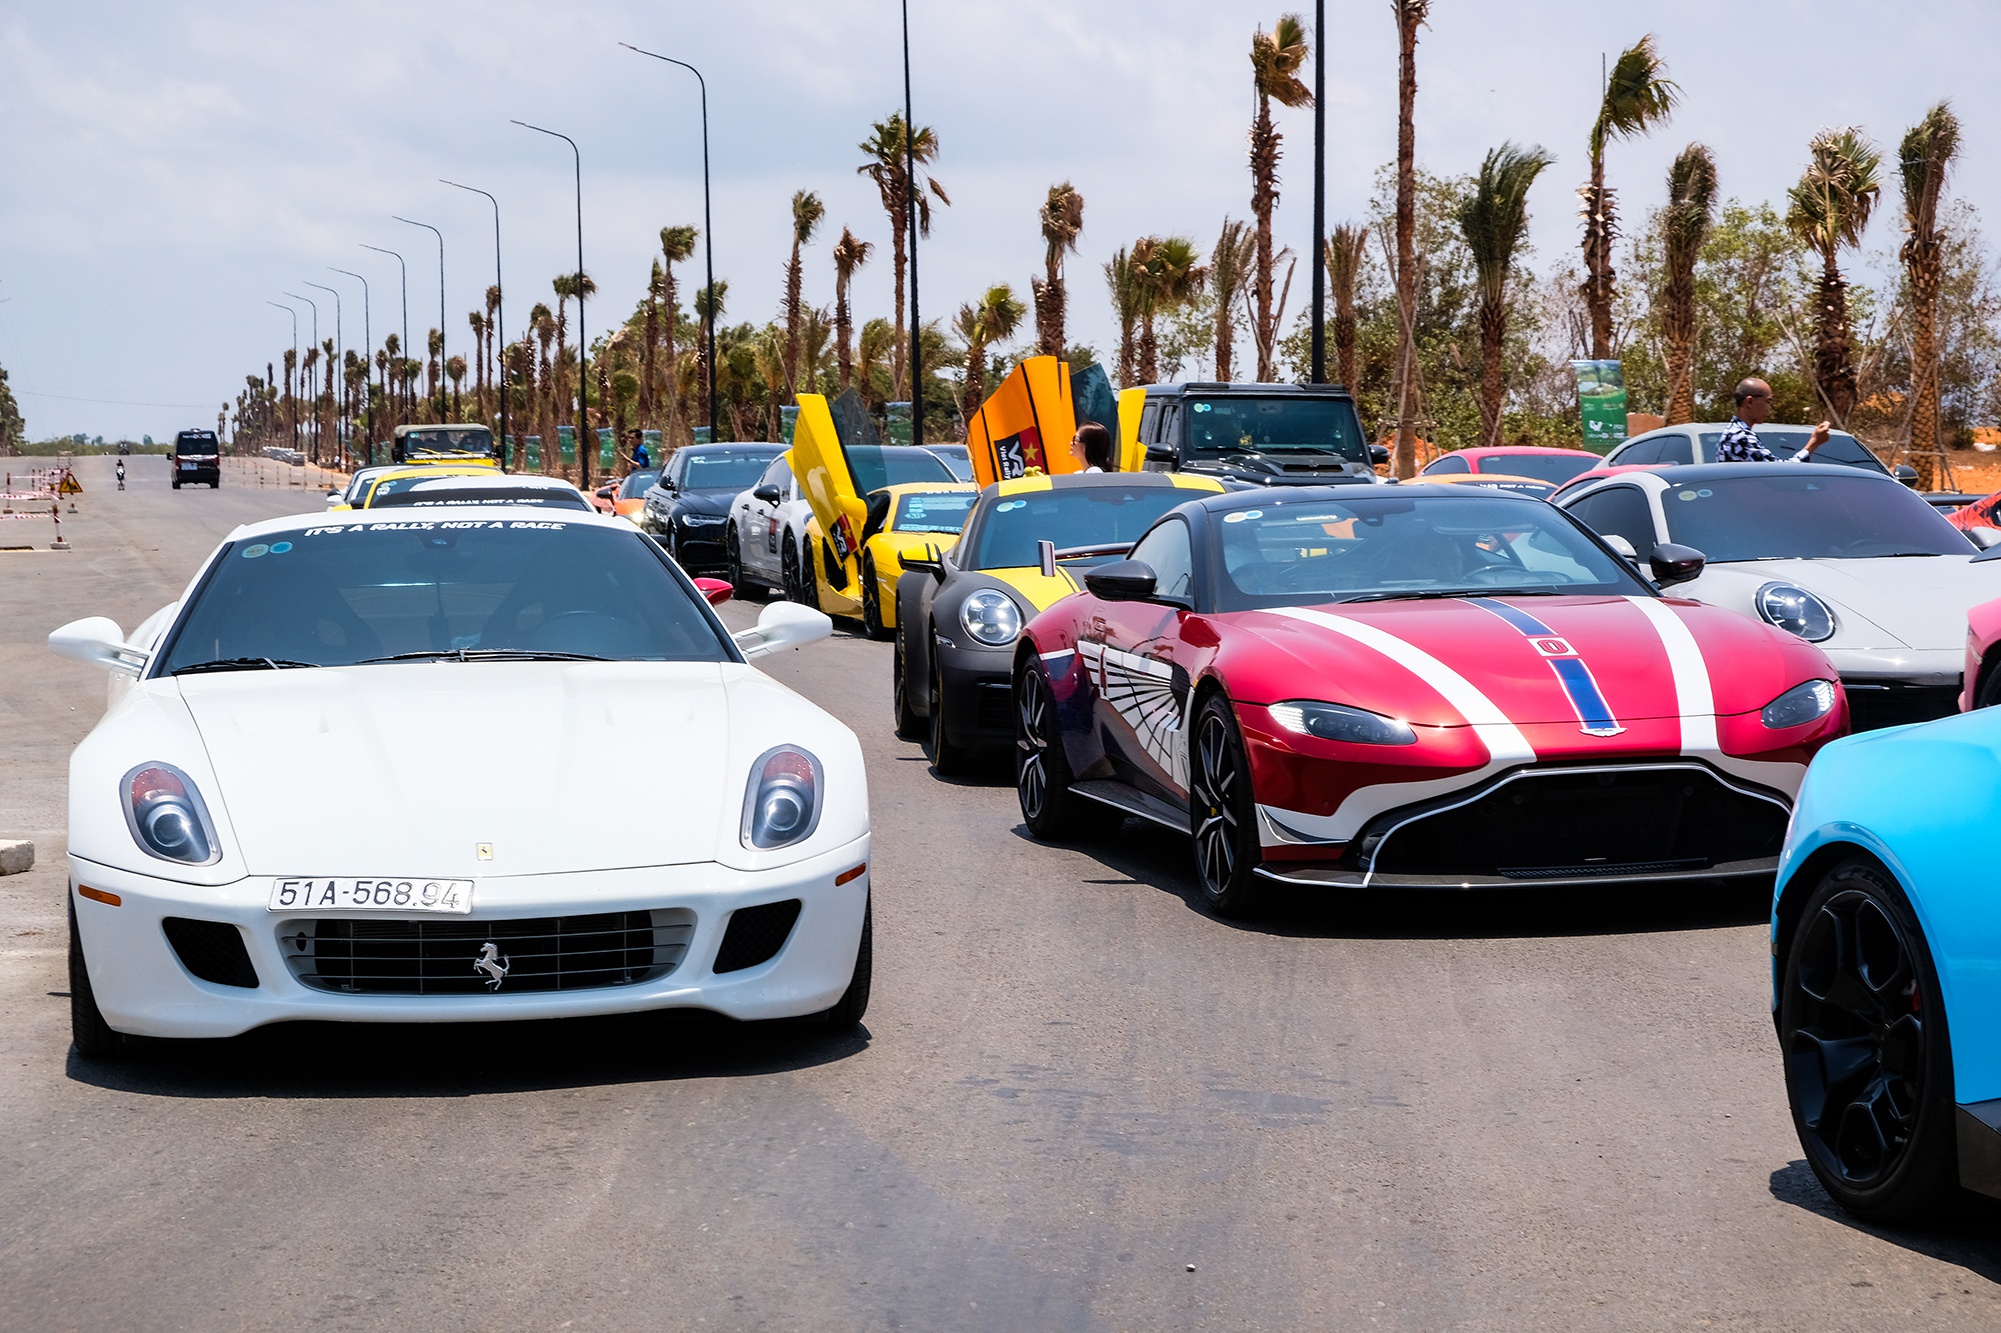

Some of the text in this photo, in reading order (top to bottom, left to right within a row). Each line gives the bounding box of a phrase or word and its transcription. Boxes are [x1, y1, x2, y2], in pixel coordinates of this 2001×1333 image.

[348, 524, 364, 532] A
[369, 522, 435, 531] RALLY,
[440, 521, 488, 529] NOT
[488, 521, 504, 529] A
[509, 522, 567, 530] RACE
[279, 880, 460, 909] 51A-568.94
